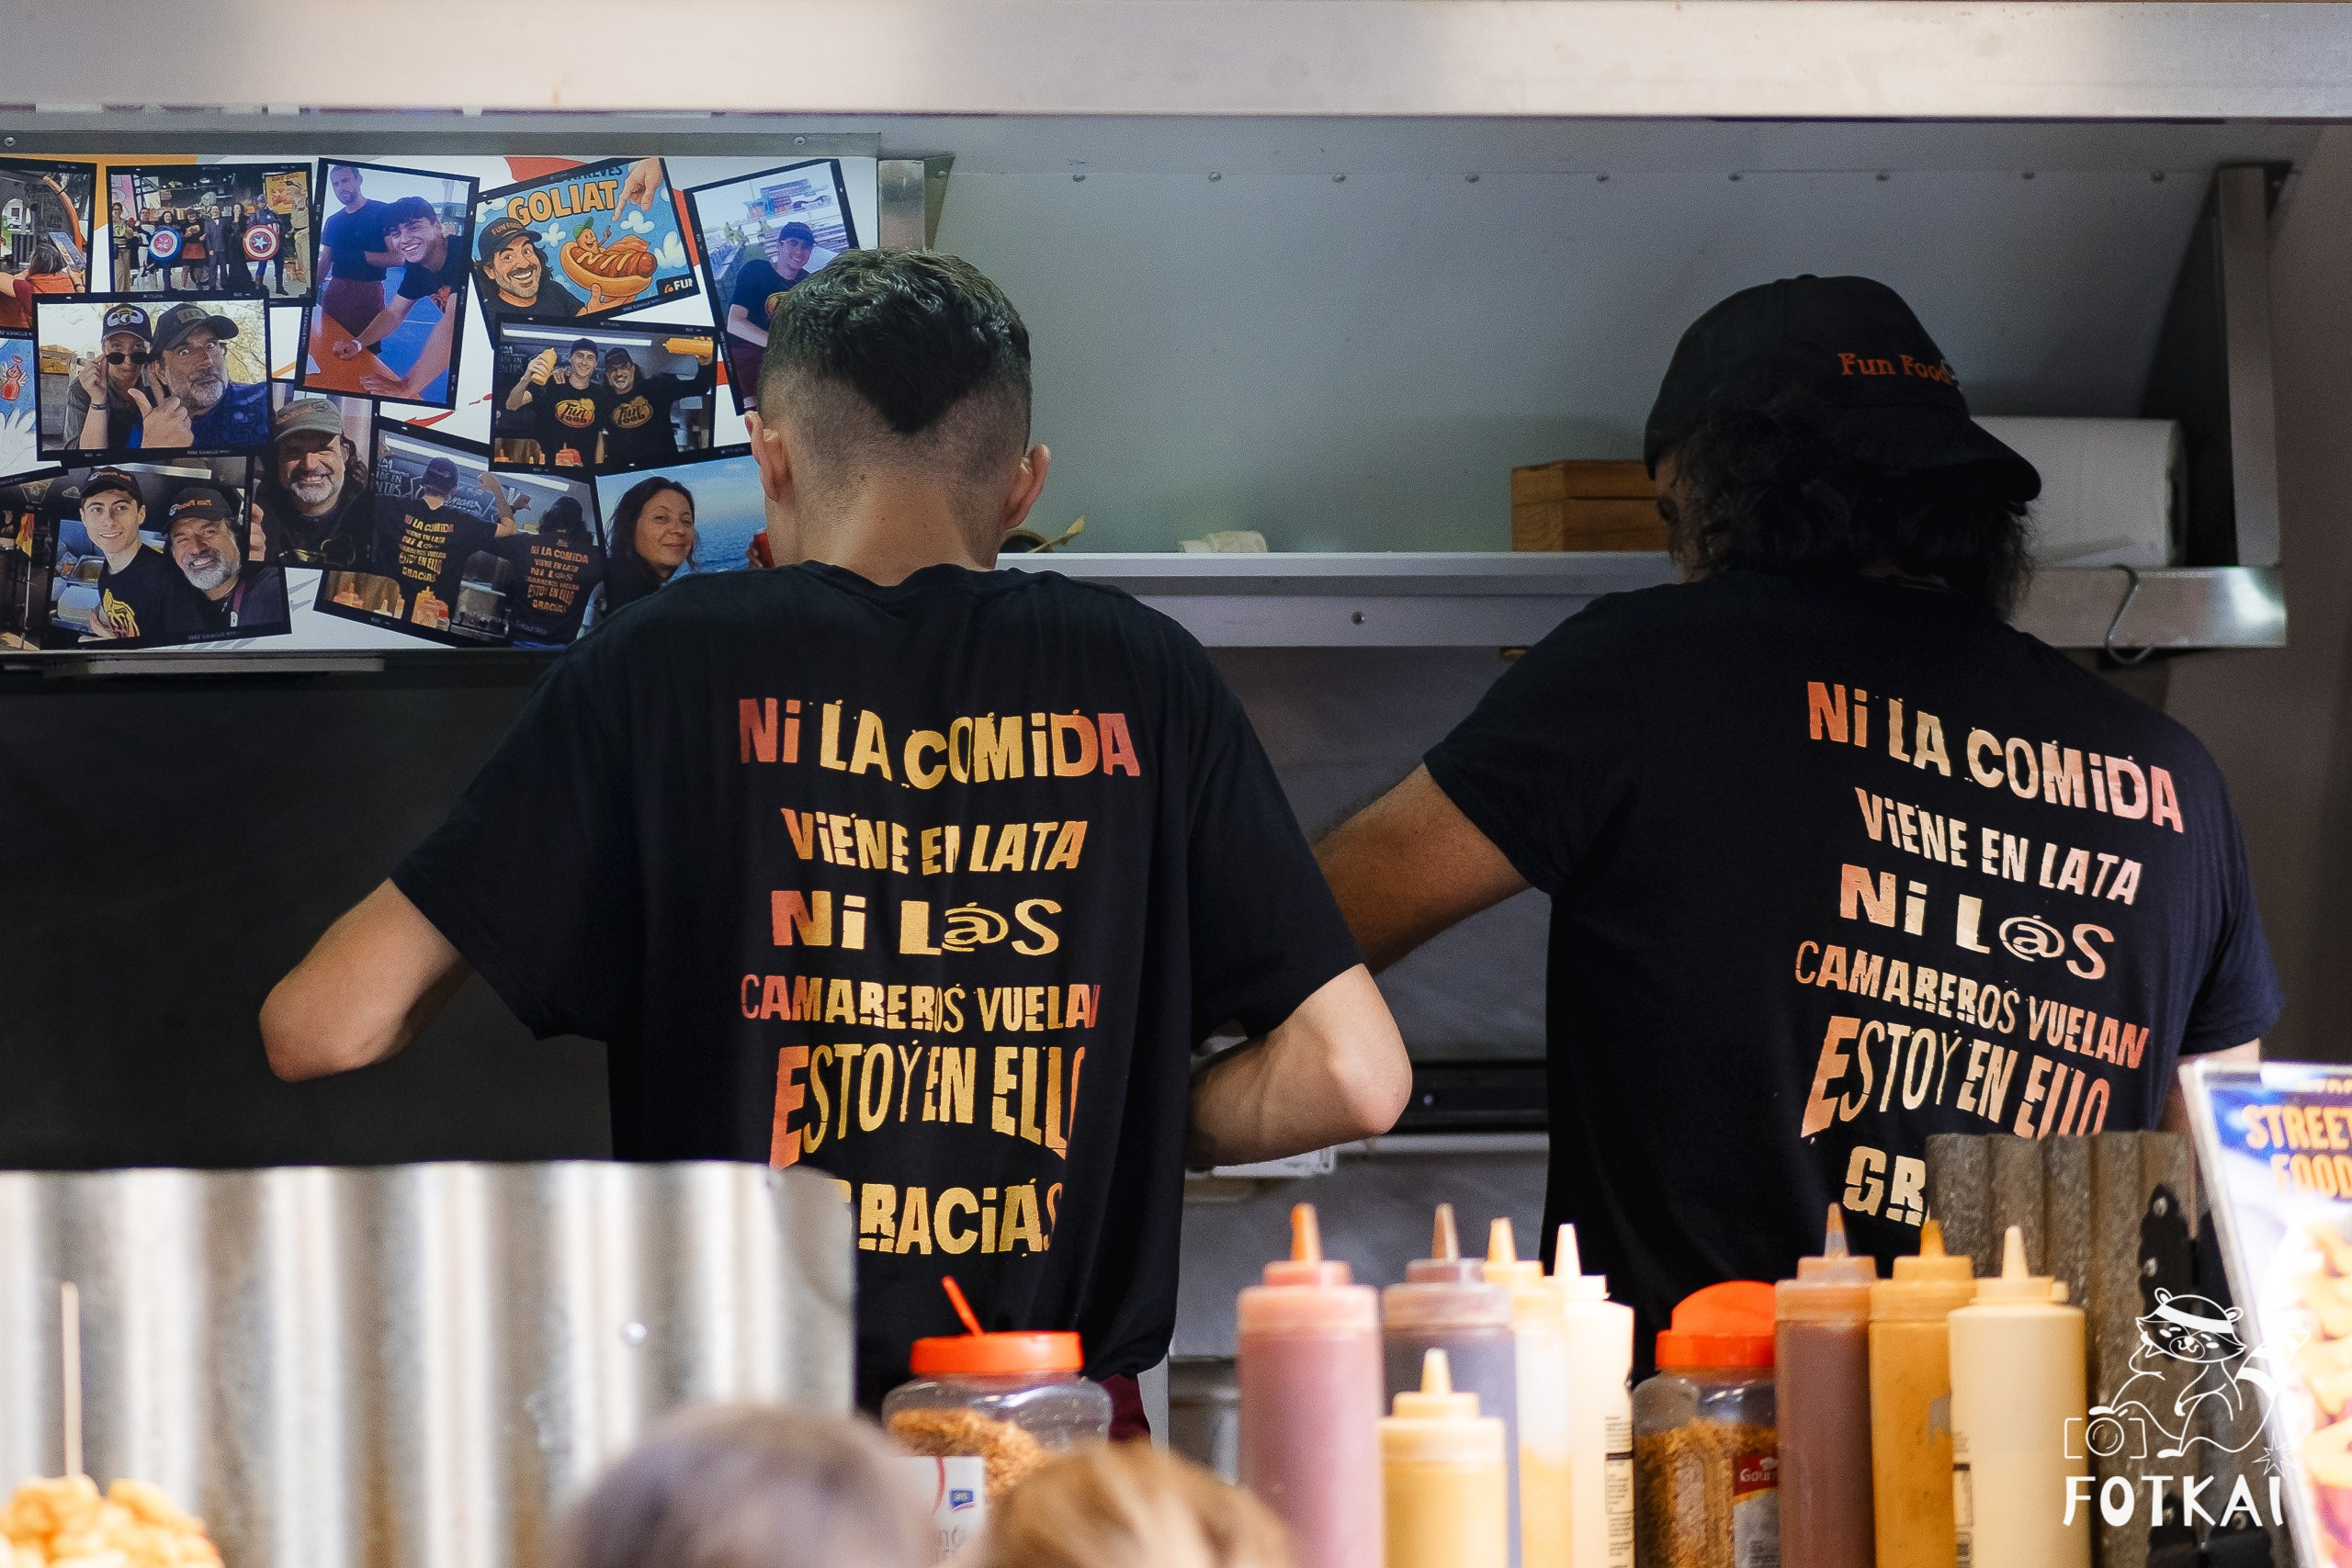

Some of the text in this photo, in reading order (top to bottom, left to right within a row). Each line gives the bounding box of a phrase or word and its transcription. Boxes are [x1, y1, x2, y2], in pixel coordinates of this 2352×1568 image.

[491, 223, 507, 236] FUN
[506, 179, 618, 228] GOLIAT
[1838, 353, 1953, 386] Fun Food
[562, 402, 586, 417] Fun
[738, 697, 1141, 790] Ni LA COMiDA
[1806, 681, 2185, 834] Ni LA COMiDA
[780, 807, 910, 874] ViENE
[967, 820, 1089, 873] LATA
[1854, 786, 2143, 906] ViENE EN LATA
[771, 890, 1062, 956] Ni L@S
[1839, 863, 2115, 980] Ni L@S
[741, 973, 966, 1033] CAMAREROS
[1794, 940, 2150, 1069] CAMAREROS VUELAN
[769, 1042, 923, 1169] ESTOY
[922, 1045, 977, 1124] EN
[1800, 1015, 1962, 1139] ESTOY
[1956, 1038, 2019, 1124] EN
[830, 1179, 1063, 1255] RACiAS
